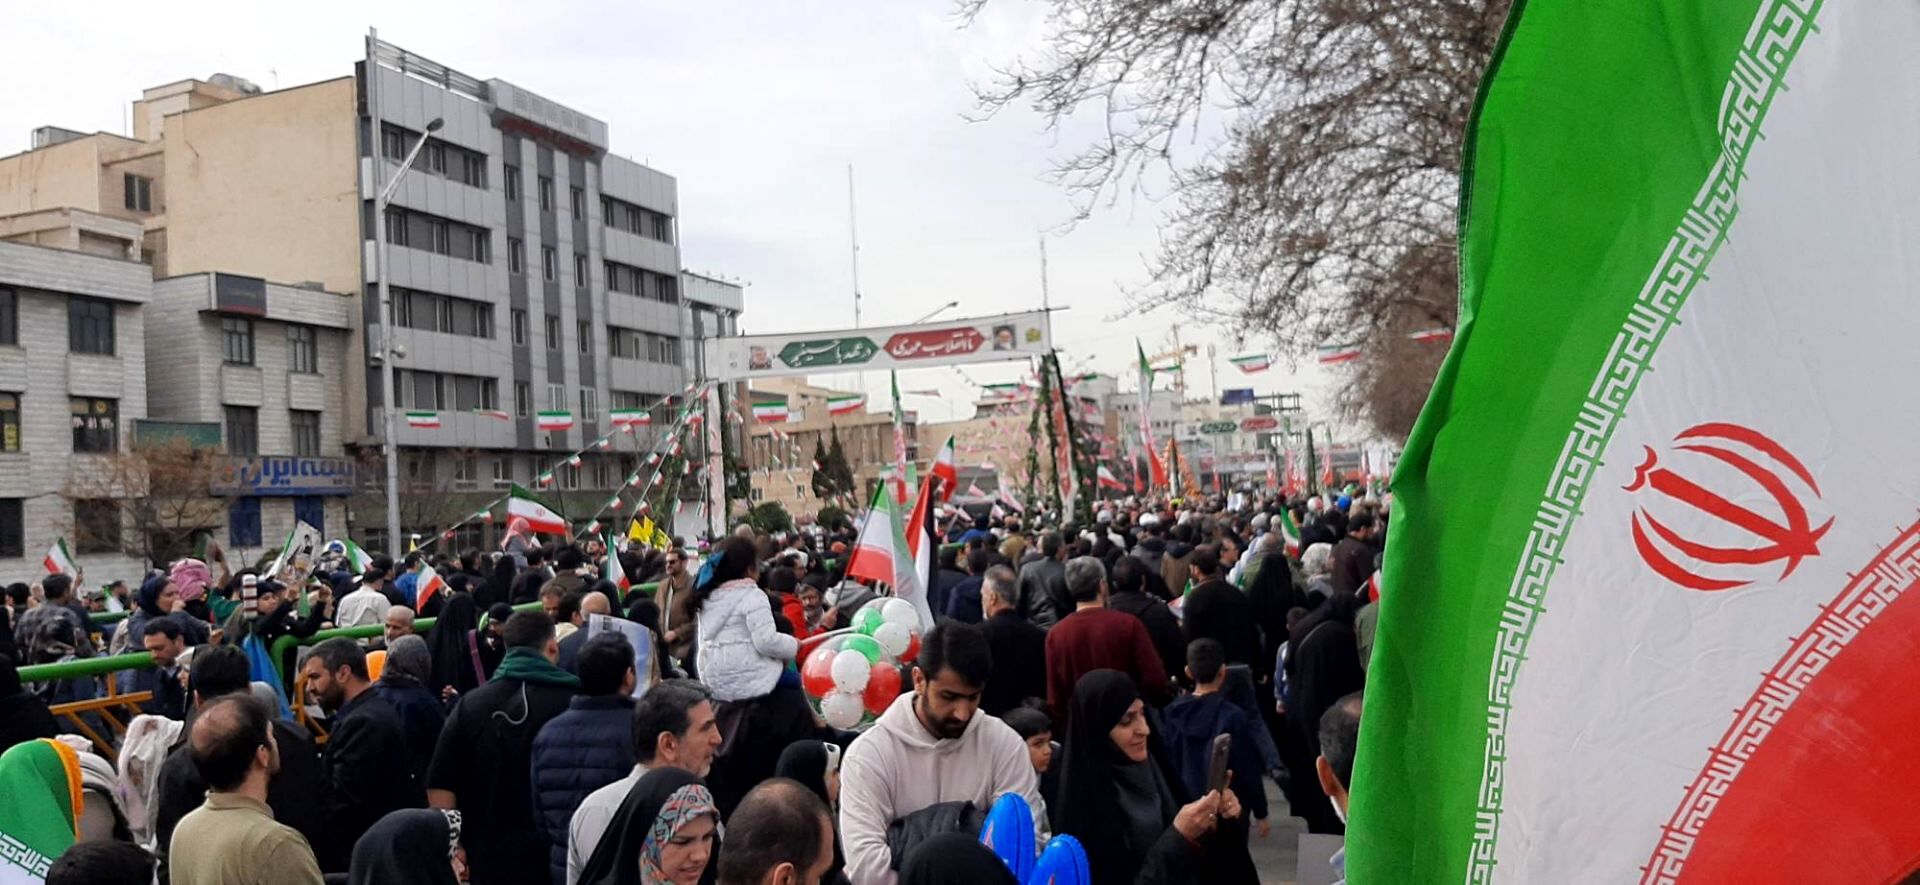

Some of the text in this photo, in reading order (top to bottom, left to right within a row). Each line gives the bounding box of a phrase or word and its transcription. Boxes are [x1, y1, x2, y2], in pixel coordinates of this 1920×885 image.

[842, 342, 862, 360] عهد
[892, 331, 978, 357] تا انقلاب مهدی
[241, 457, 353, 485] بیمه ایران
